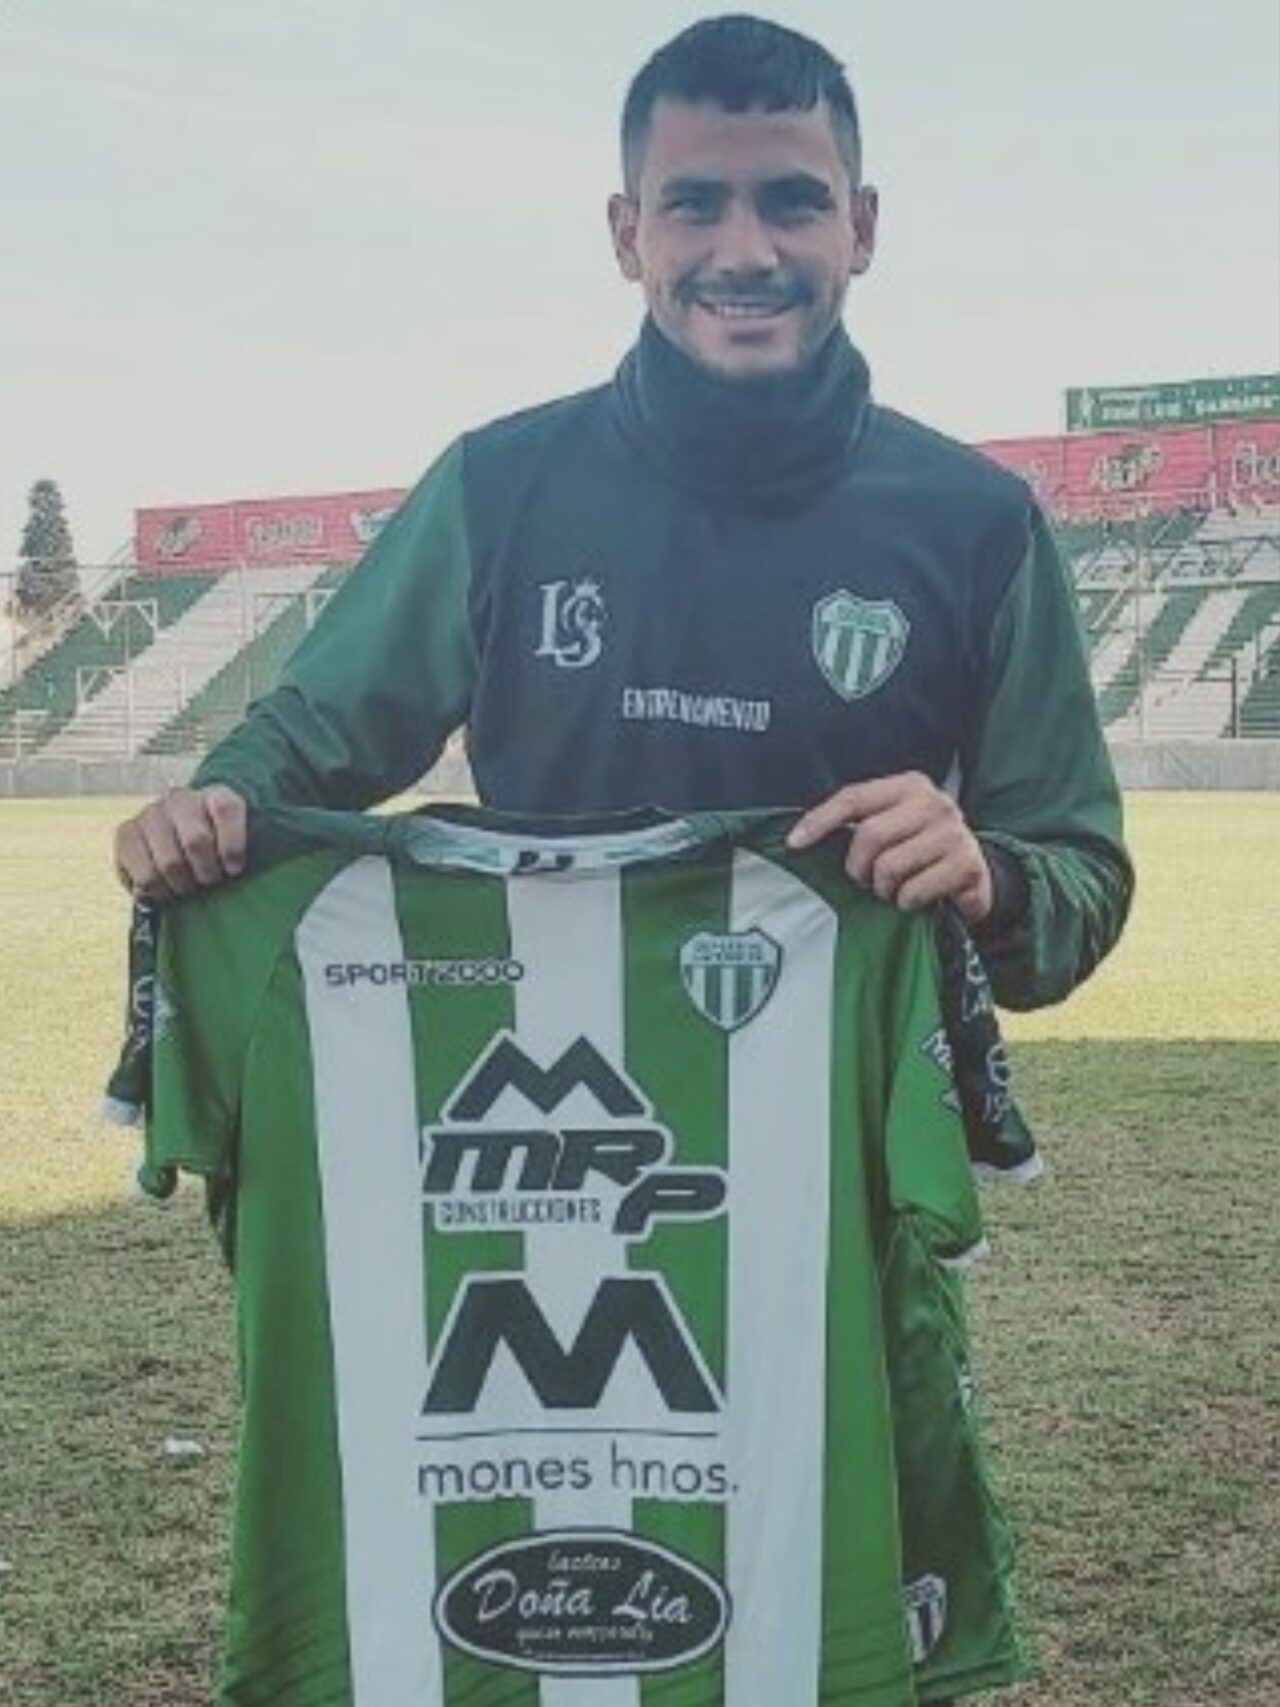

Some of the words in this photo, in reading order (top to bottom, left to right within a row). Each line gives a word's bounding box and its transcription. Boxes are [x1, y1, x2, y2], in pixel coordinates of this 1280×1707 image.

[417, 1457, 592, 1495] mones
[610, 1439, 740, 1494] hnos.
[472, 1569, 597, 1623] Doña
